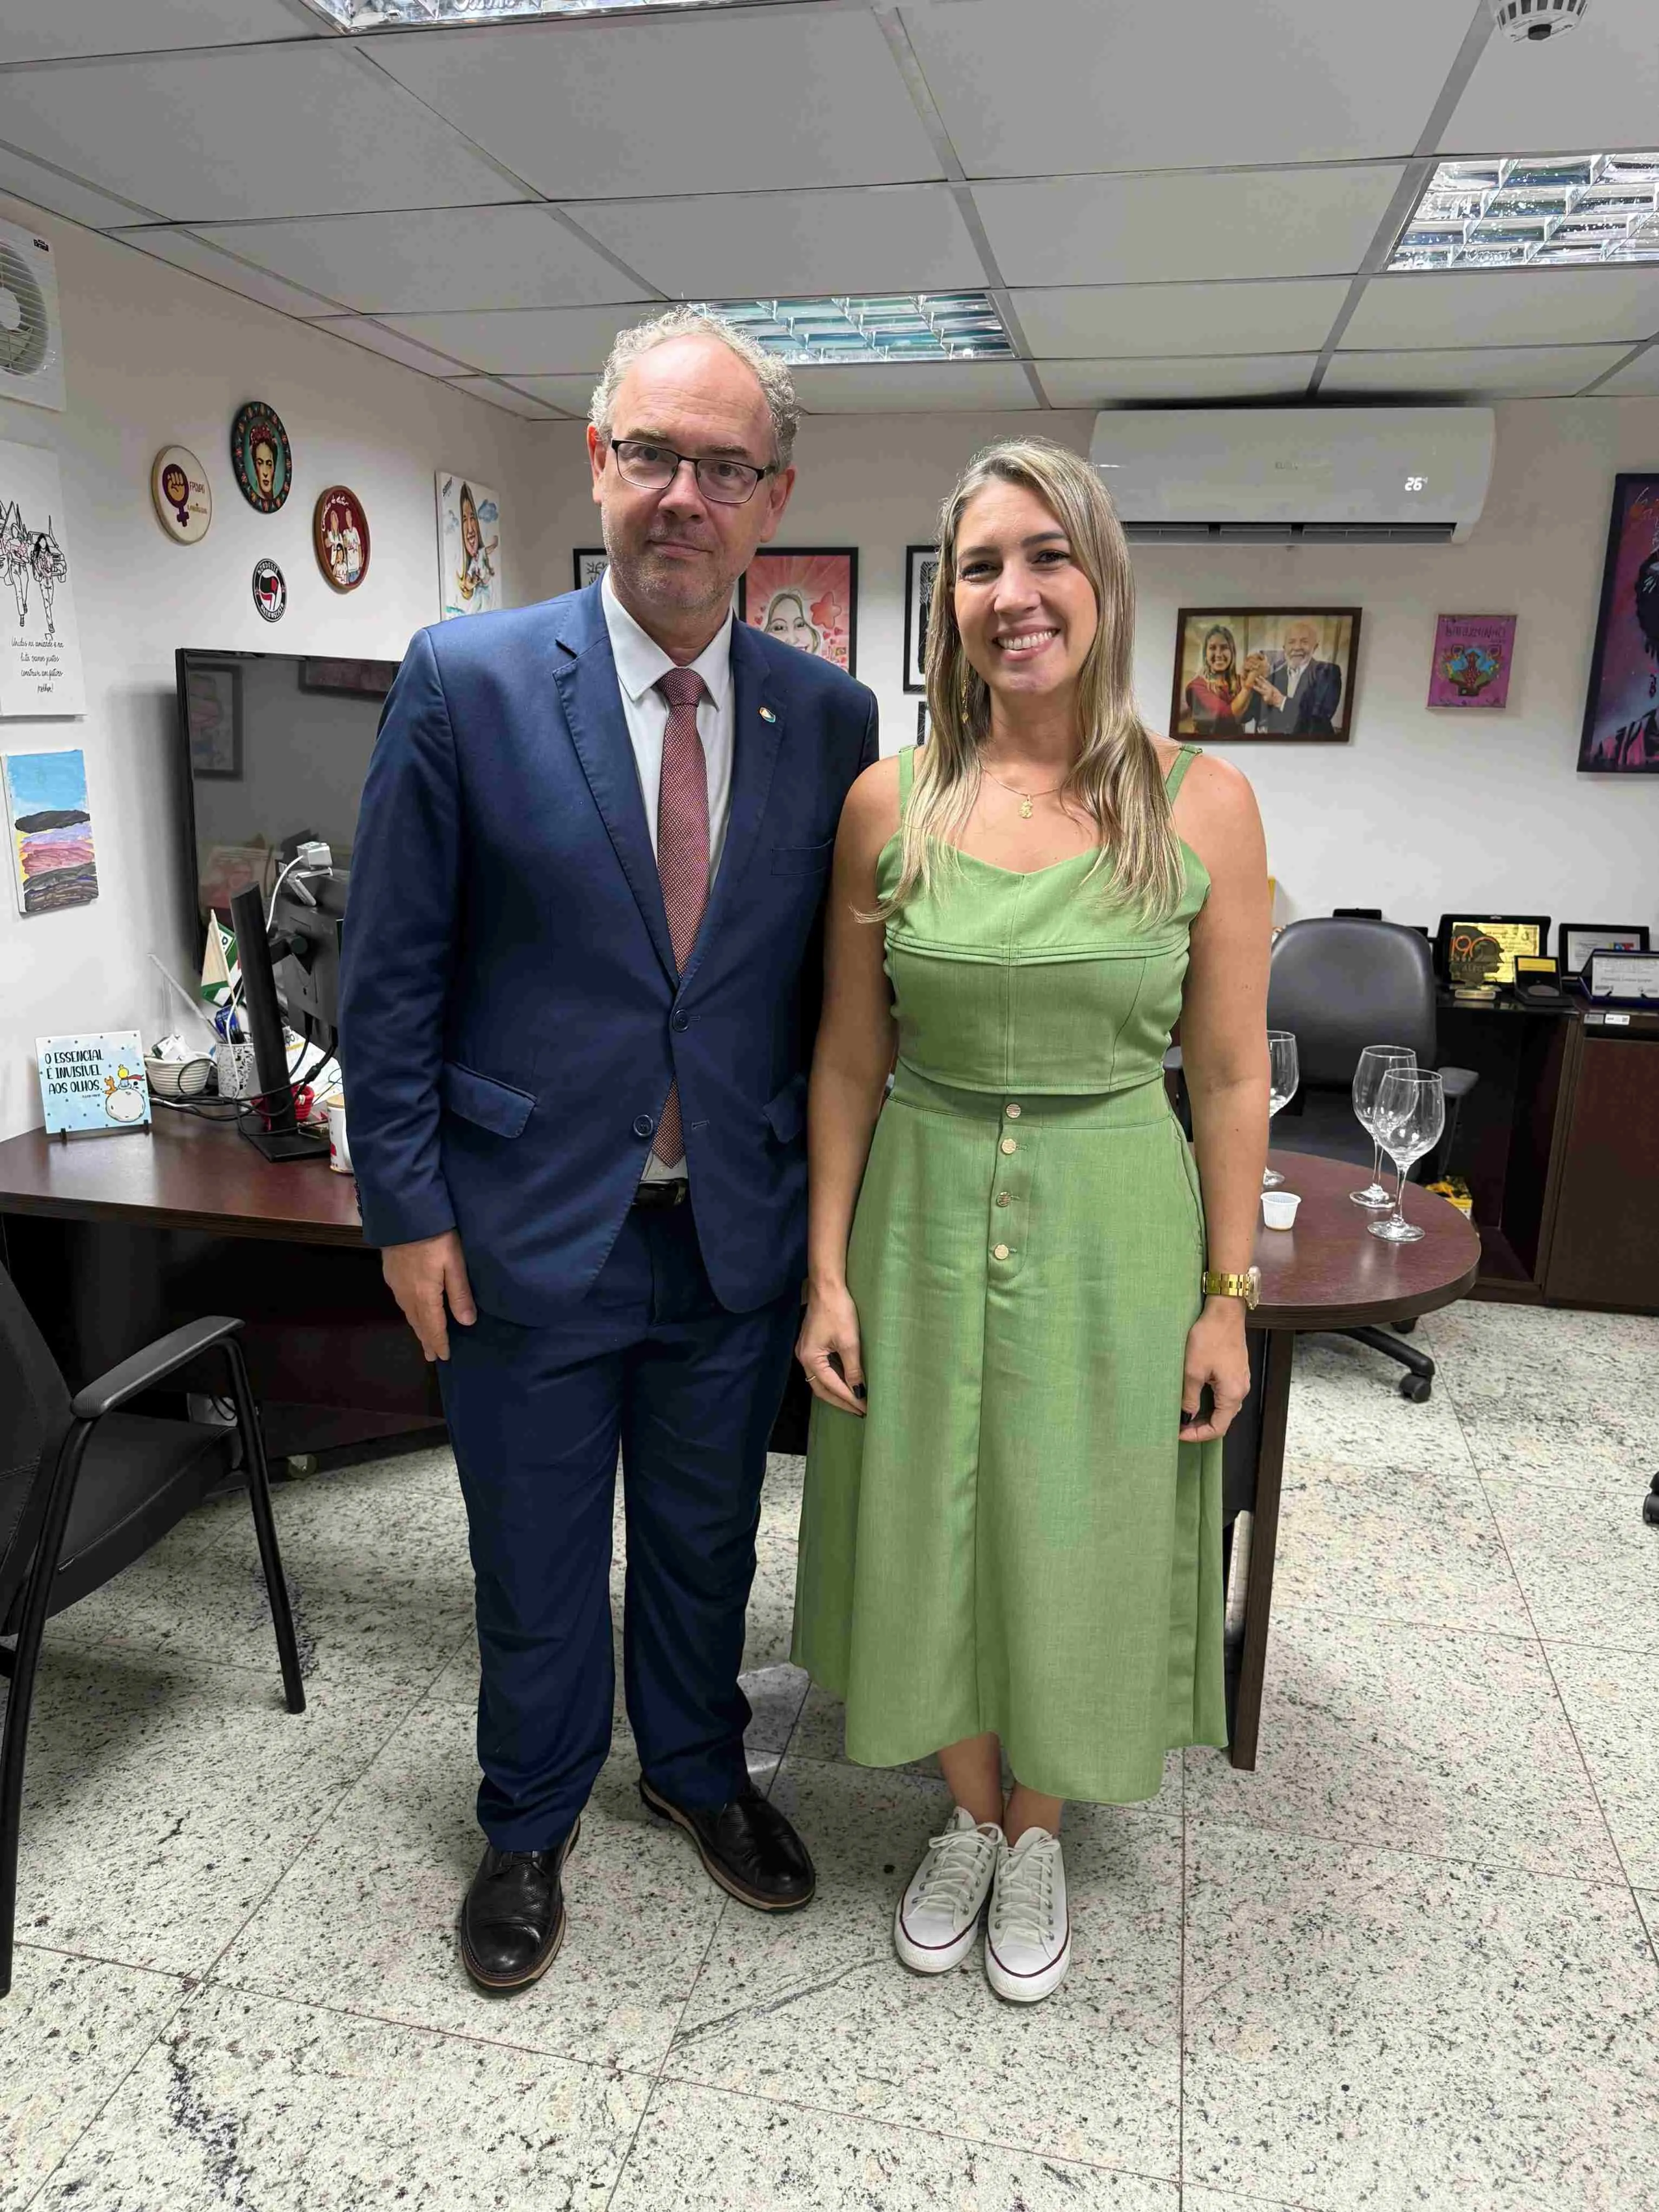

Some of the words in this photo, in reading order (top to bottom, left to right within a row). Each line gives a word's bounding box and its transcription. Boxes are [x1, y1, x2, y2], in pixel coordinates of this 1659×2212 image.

[45, 1053, 51, 1064] O
[55, 1049, 104, 1064] ESSENCIAL
[47, 1066, 54, 1079] É
[55, 1063, 102, 1078] INVISÍVEL
[49, 1082, 68, 1095] AOS
[70, 1079, 102, 1092] OLHOS.
